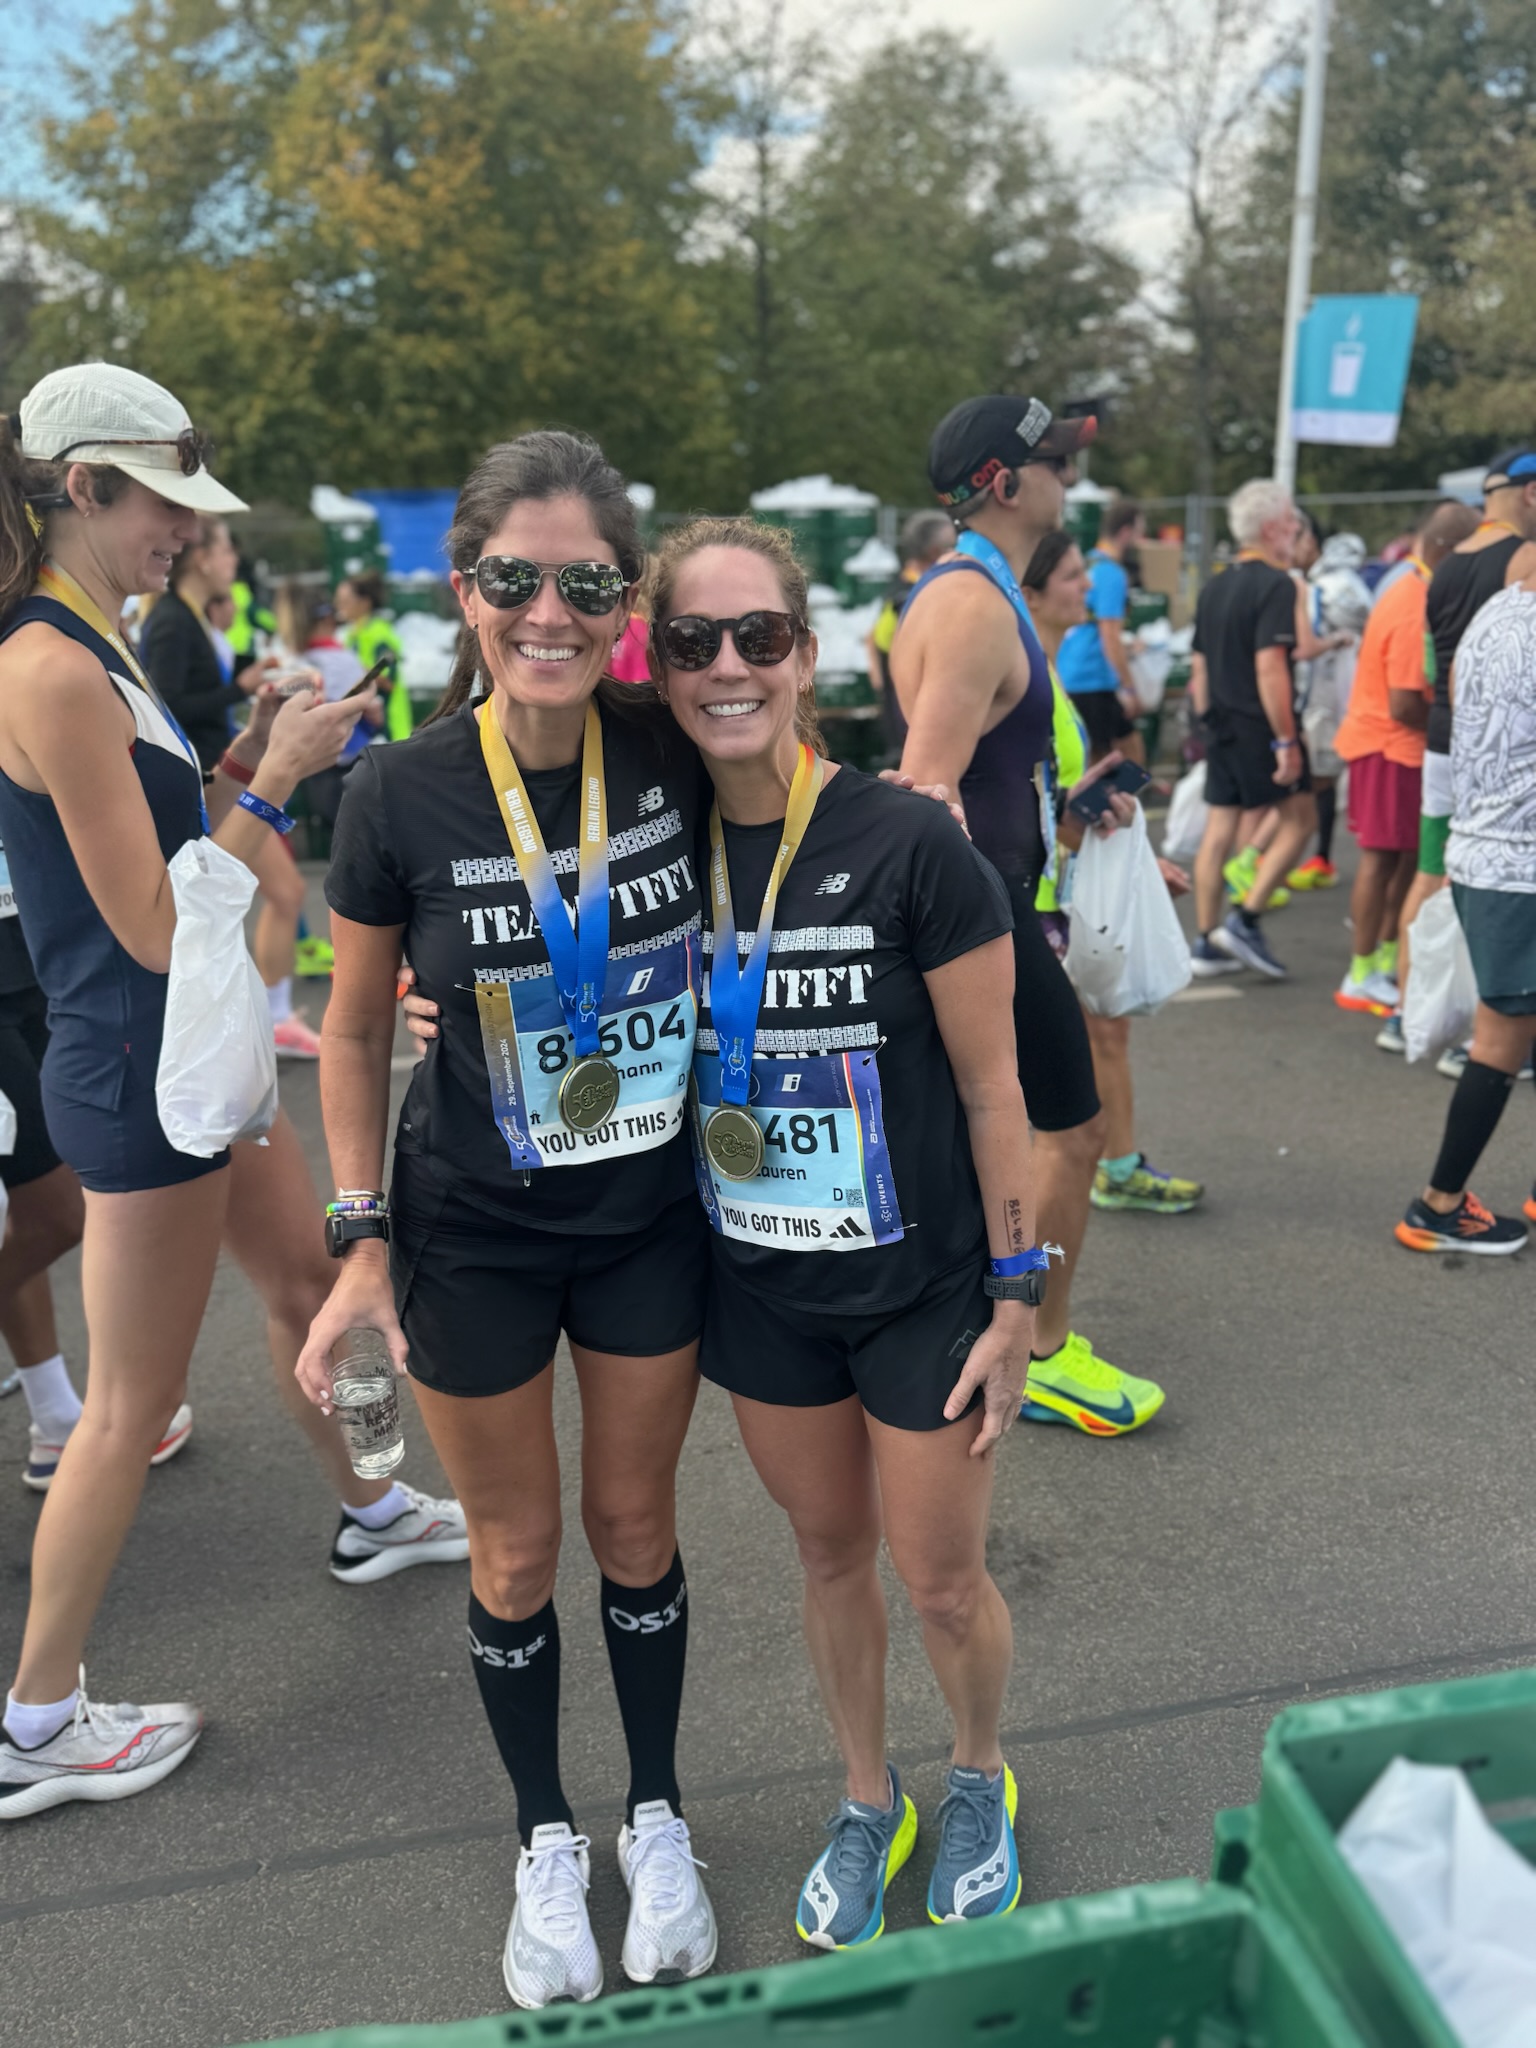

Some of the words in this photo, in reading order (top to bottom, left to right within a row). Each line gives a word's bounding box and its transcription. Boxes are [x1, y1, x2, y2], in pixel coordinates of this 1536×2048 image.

[505, 788, 524, 821] BERLIN
[588, 777, 600, 810] LEGEND
[514, 818, 538, 853] LEGEND
[587, 811, 601, 842] BERLIN
[714, 844, 723, 874] BERLIN
[715, 873, 727, 905] LEGEND
[500, 1039, 509, 1057] 2024
[537, 1003, 686, 1075] 8604
[503, 1056, 515, 1094] September
[508, 1094, 517, 1106] 29.
[537, 1130, 577, 1154] YOU
[584, 1121, 619, 1147] GOT
[624, 1111, 667, 1139] THIS
[757, 1113, 839, 1154] 481
[833, 1188, 843, 1202] D
[875, 1174, 887, 1204] EVENTS
[722, 1206, 747, 1229] YOU
[751, 1213, 779, 1235] GOT
[782, 1217, 822, 1238] THIS
[638, 1805, 666, 1815] saucony
[537, 1828, 566, 1837] saucony
